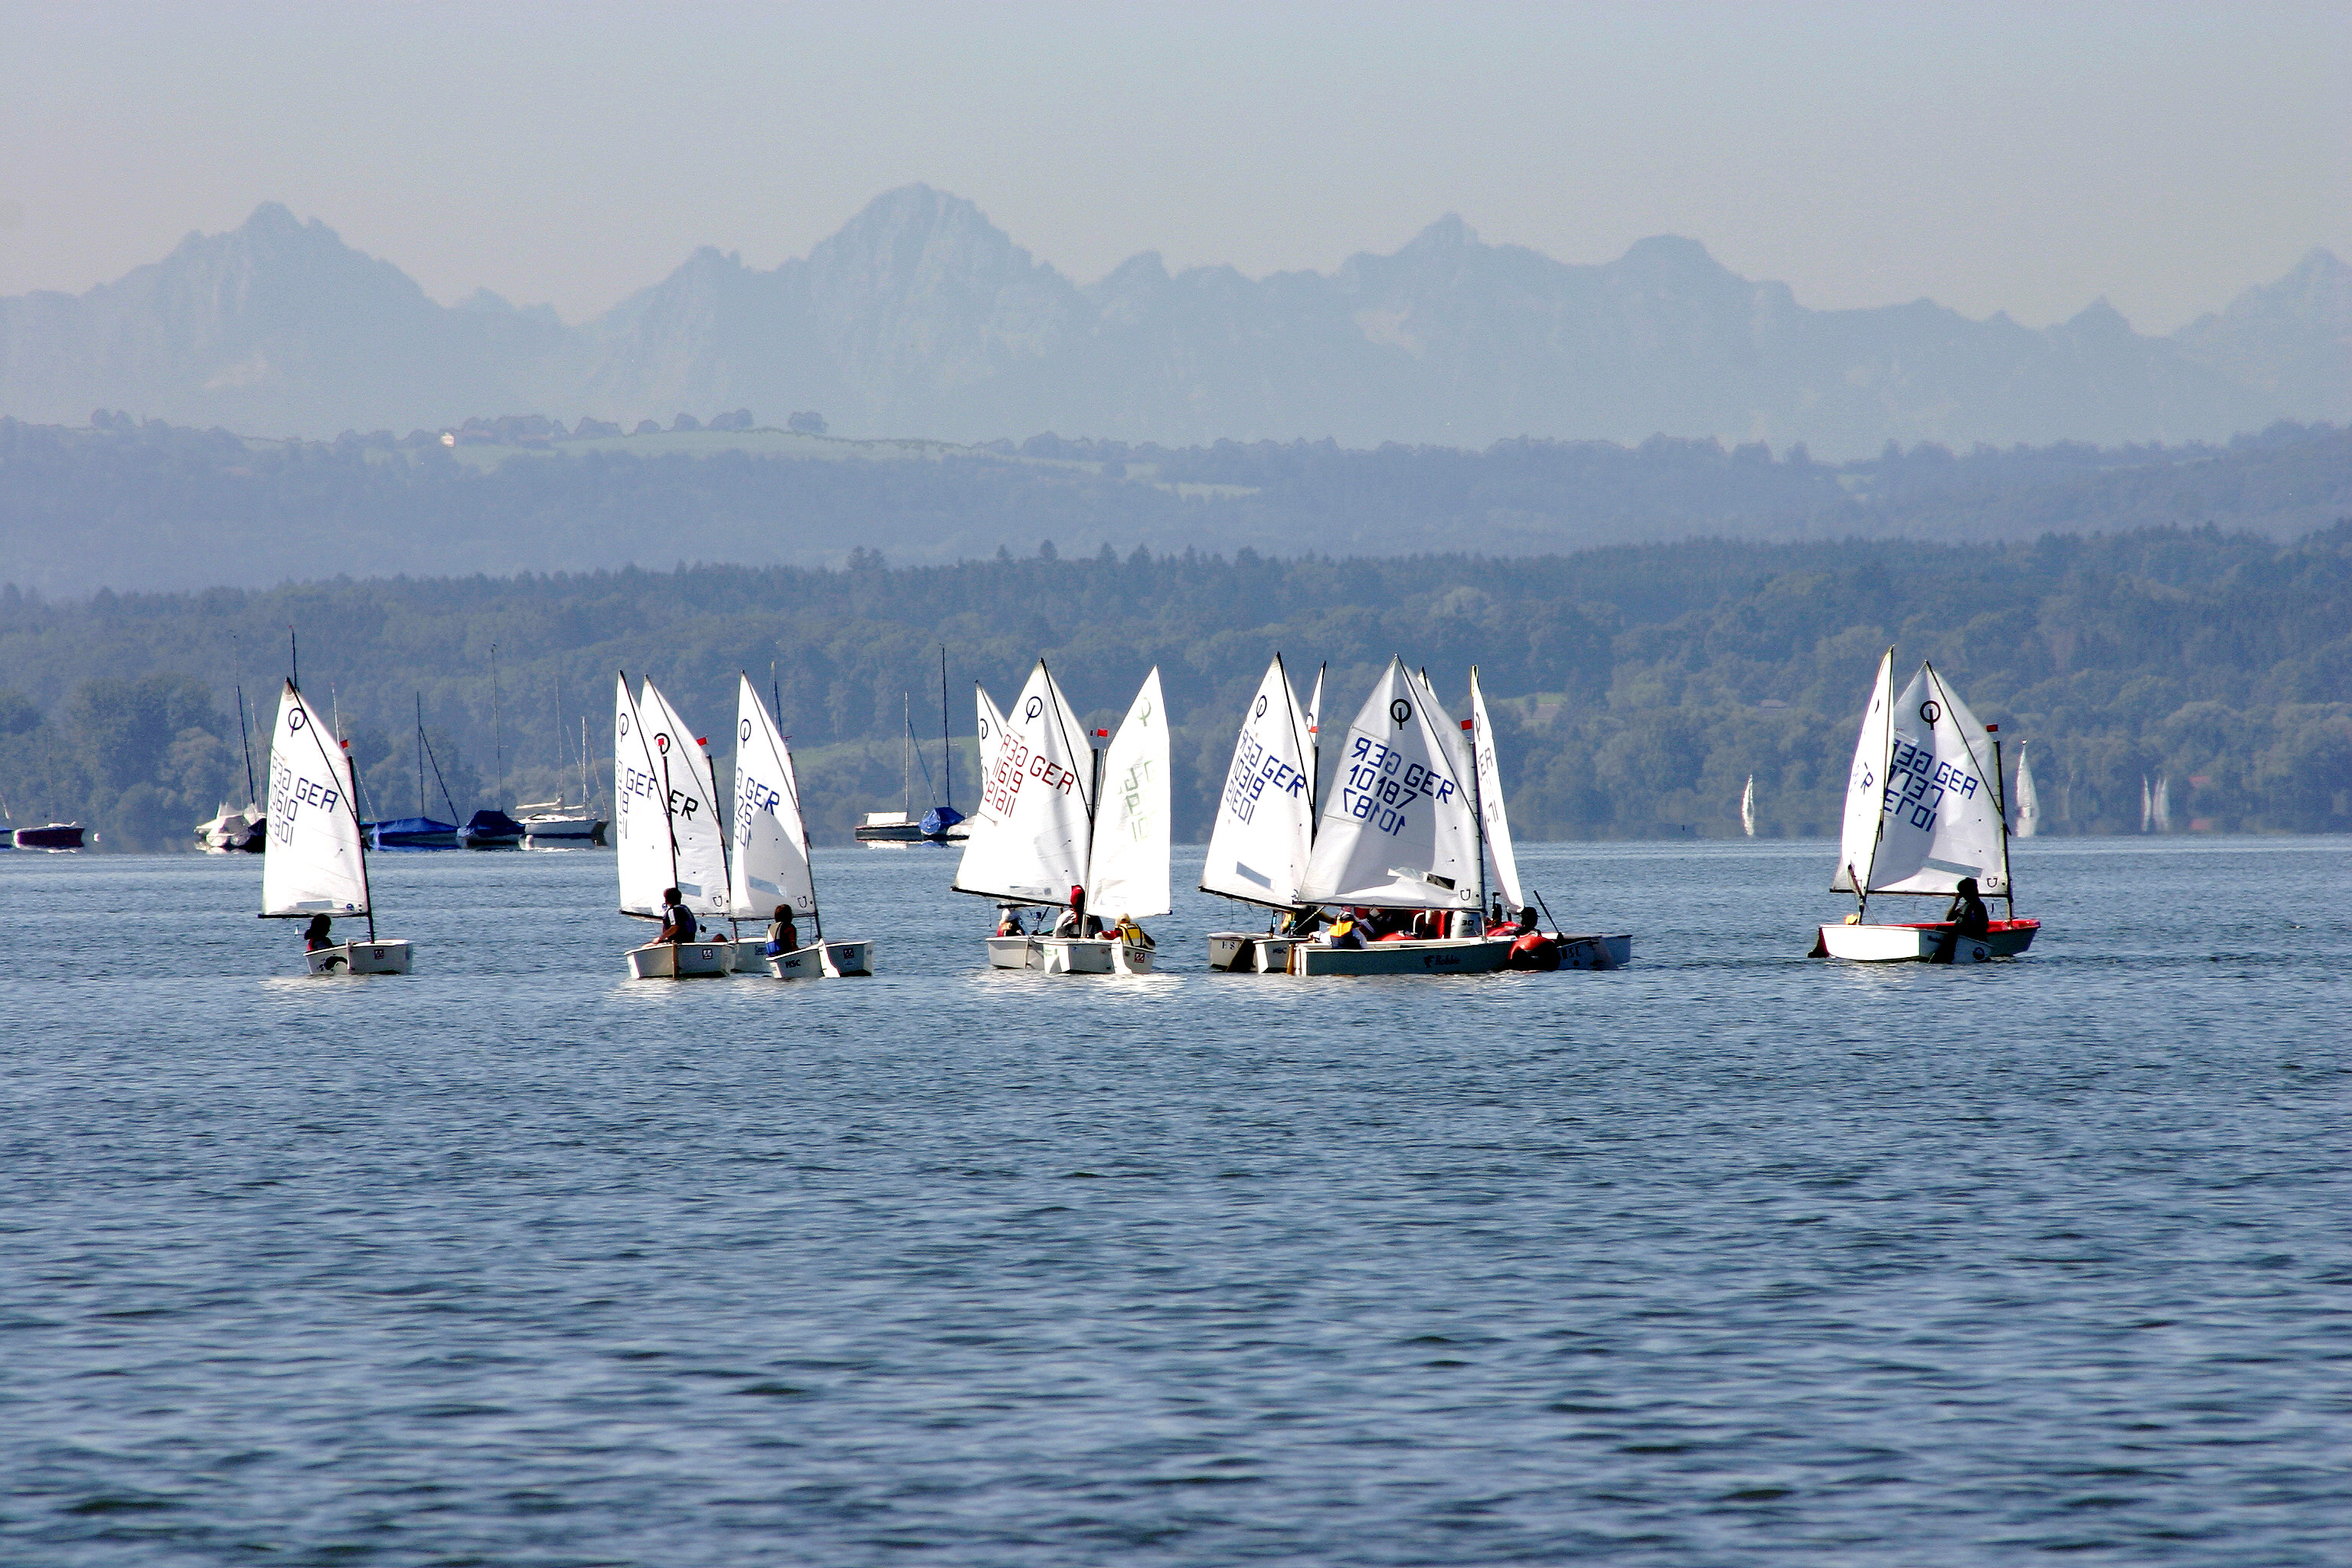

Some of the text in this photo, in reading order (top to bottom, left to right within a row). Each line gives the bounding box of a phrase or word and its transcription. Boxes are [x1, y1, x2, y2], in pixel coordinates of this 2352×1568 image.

[992, 756, 1024, 793] 11619
[1030, 755, 1075, 795] GER
[1233, 755, 1266, 801] 10319
[1261, 755, 1305, 798] GER
[1349, 764, 1418, 809] 10187
[1403, 763, 1455, 804] GER
[1934, 761, 1978, 799] GER
[296, 777, 339, 812] GER
[670, 789, 699, 822] ER
[746, 777, 780, 816] GER
[785, 959, 802, 969] HSC
